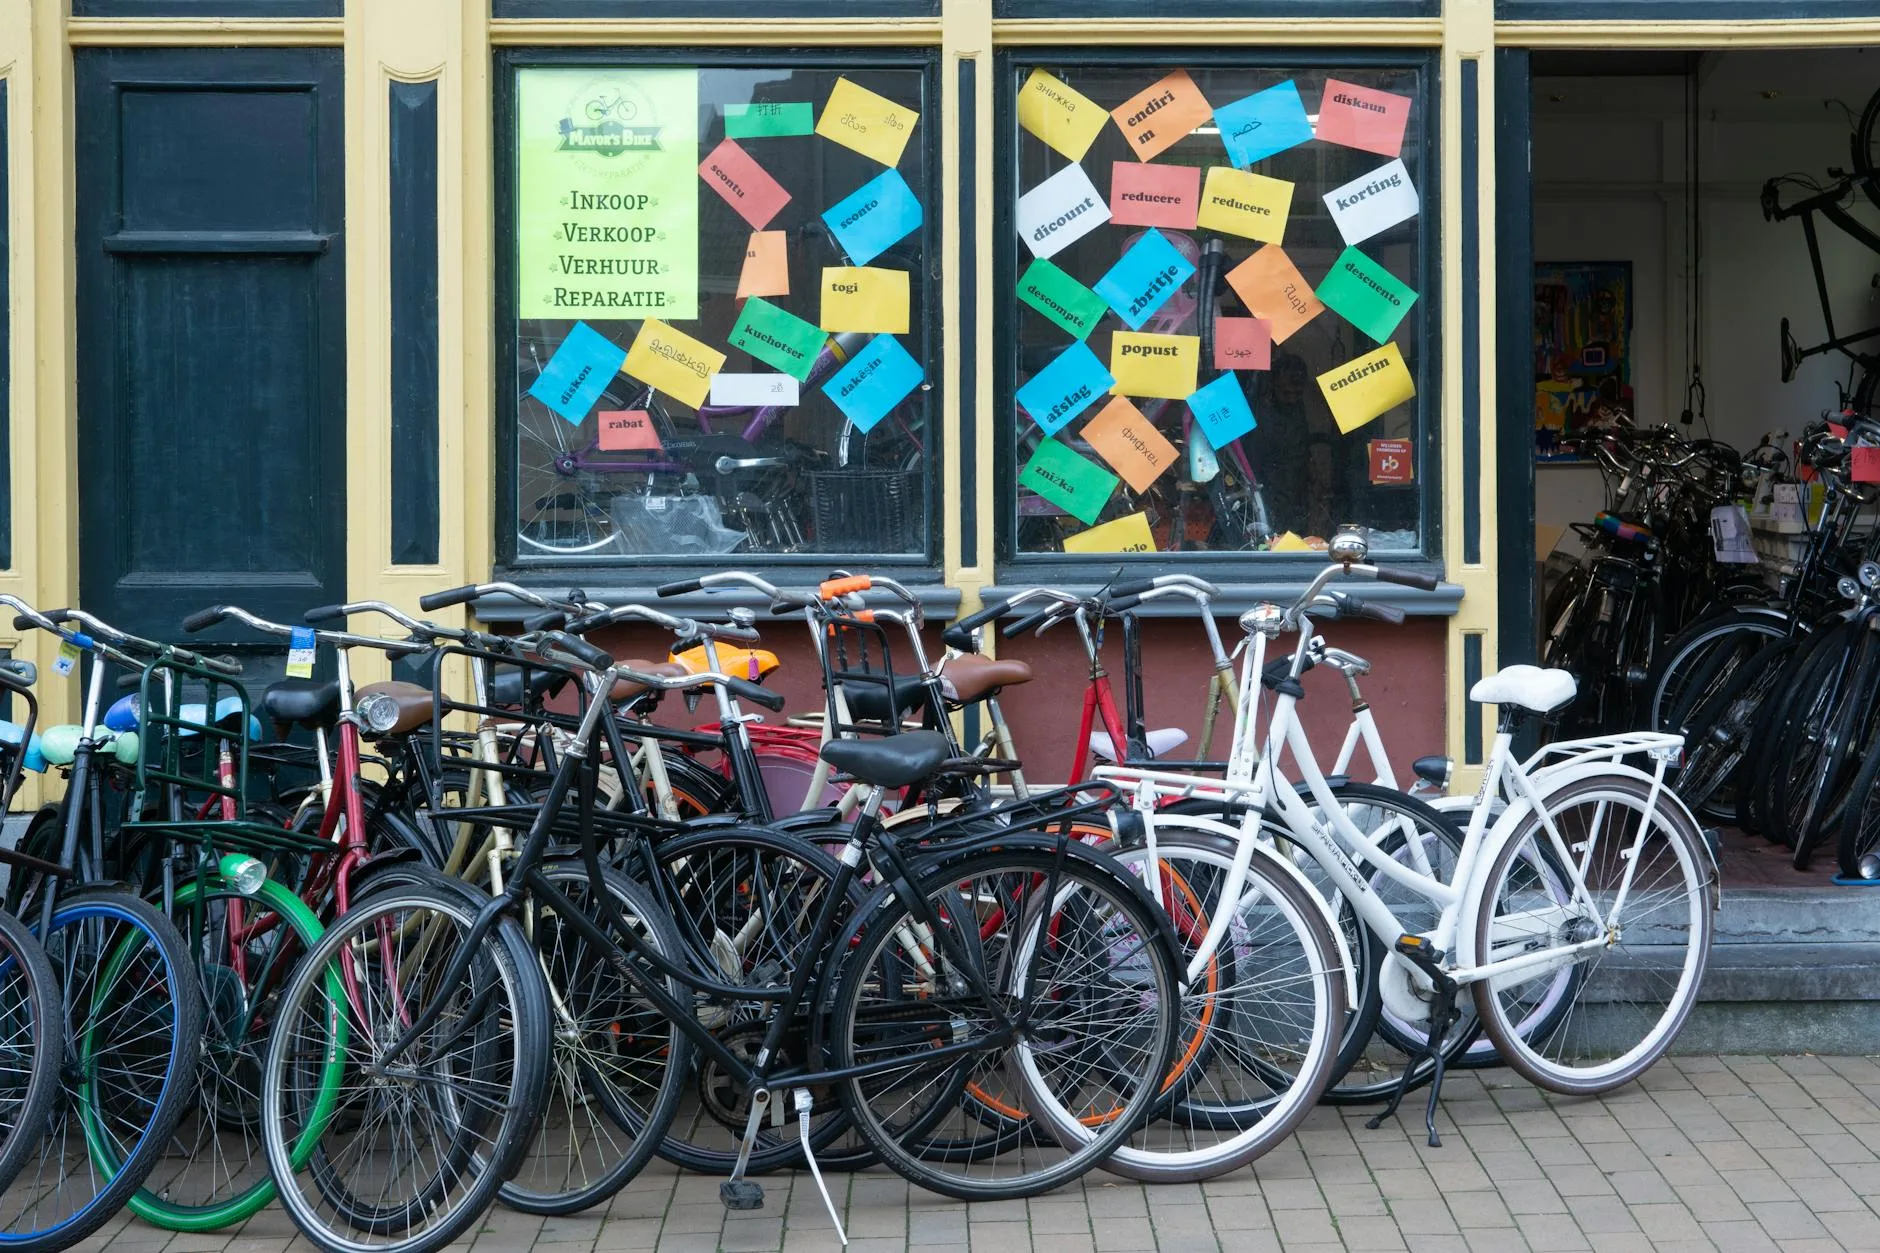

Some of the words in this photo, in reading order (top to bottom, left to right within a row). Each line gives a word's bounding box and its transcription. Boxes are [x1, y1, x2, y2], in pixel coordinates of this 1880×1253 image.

[1035, 82, 1076, 112] знижка
[1128, 90, 1176, 127] endiri
[1333, 93, 1387, 114] diskaun
[1138, 128, 1156, 145] m
[1232, 117, 1262, 142] خصم
[710, 163, 745, 199] scontu
[1335, 172, 1402, 212] korting
[570, 190, 649, 210] INKOOP
[1121, 191, 1181, 205] reducere
[1211, 195, 1271, 217] reducere
[839, 199, 879, 230] sconto
[1033, 196, 1095, 242] dicount
[562, 222, 656, 242] VERKOOP
[558, 255, 660, 275] VERHUUR
[553, 287, 666, 307] REPARATIE
[831, 282, 858, 295] togi
[1128, 264, 1179, 317] zbritje
[1345, 261, 1402, 307] descuento
[1027, 284, 1085, 328] descompte
[737, 338, 746, 347] a
[744, 324, 805, 360] kuchotser
[1121, 343, 1179, 358] popust
[560, 364, 592, 406] diskon
[839, 356, 882, 398] dakêşin
[1329, 356, 1391, 392] endirim
[1045, 383, 1093, 424] afslag
[608, 418, 644, 429] rabat
[1121, 426, 1159, 467] тахфиф
